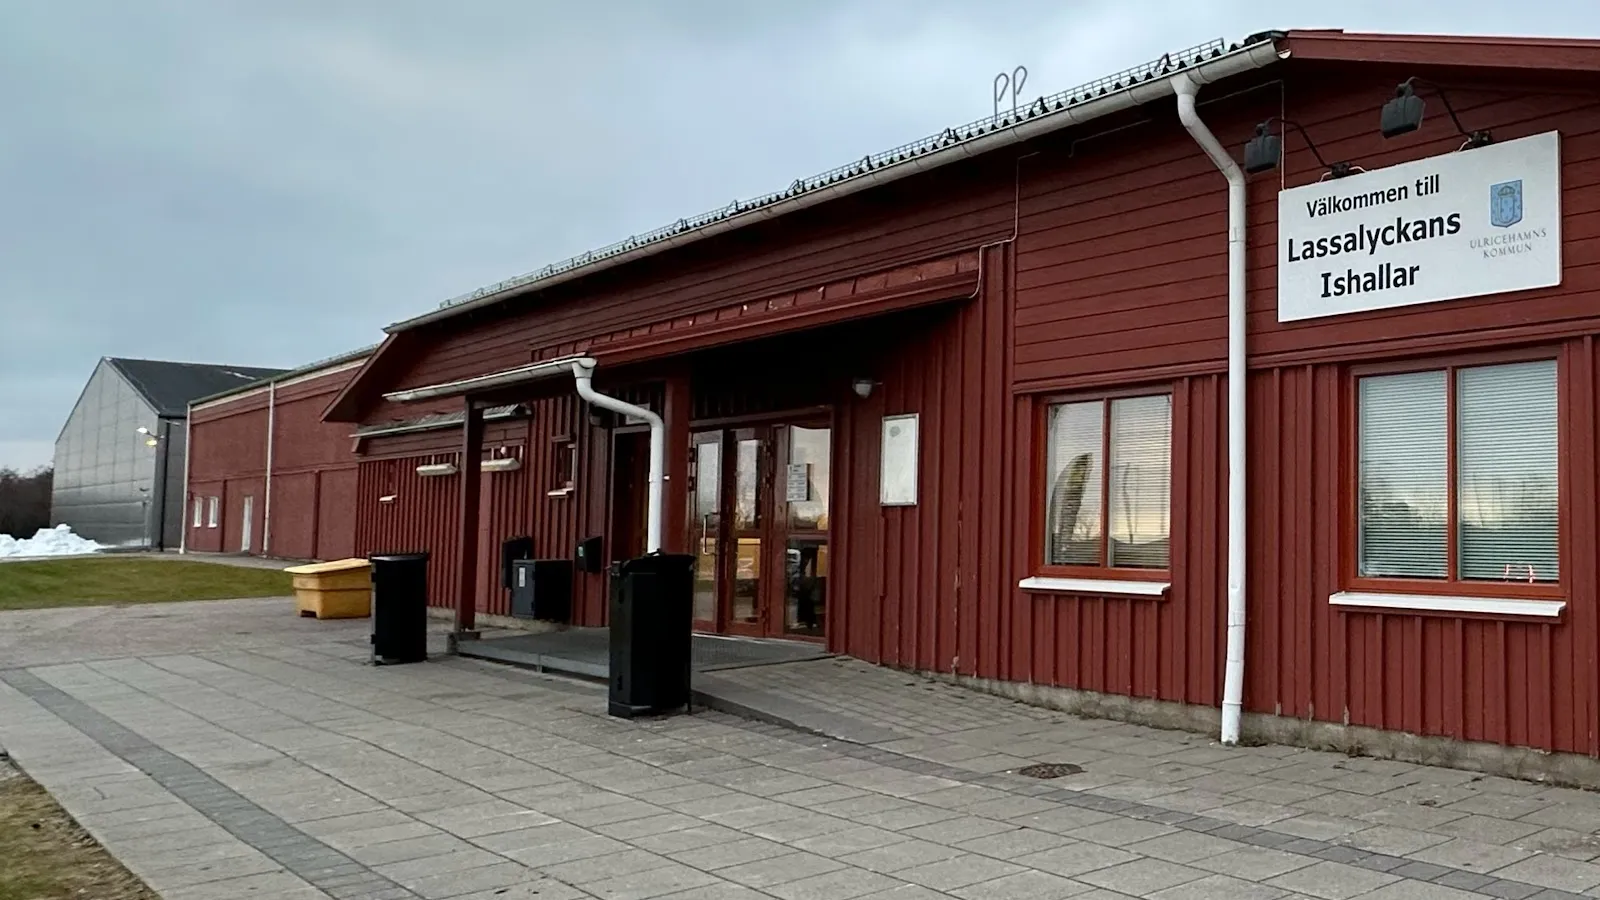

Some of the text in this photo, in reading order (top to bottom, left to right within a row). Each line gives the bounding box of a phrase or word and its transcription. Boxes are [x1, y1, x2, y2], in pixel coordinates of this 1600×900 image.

[1306, 174, 1440, 218] Välkommen till
[1287, 212, 1461, 262] Lassalyckans
[1469, 228, 1547, 249] ULRICEHAMNS
[1483, 242, 1532, 259] KOMMUN
[1321, 263, 1420, 298] Ishallar
